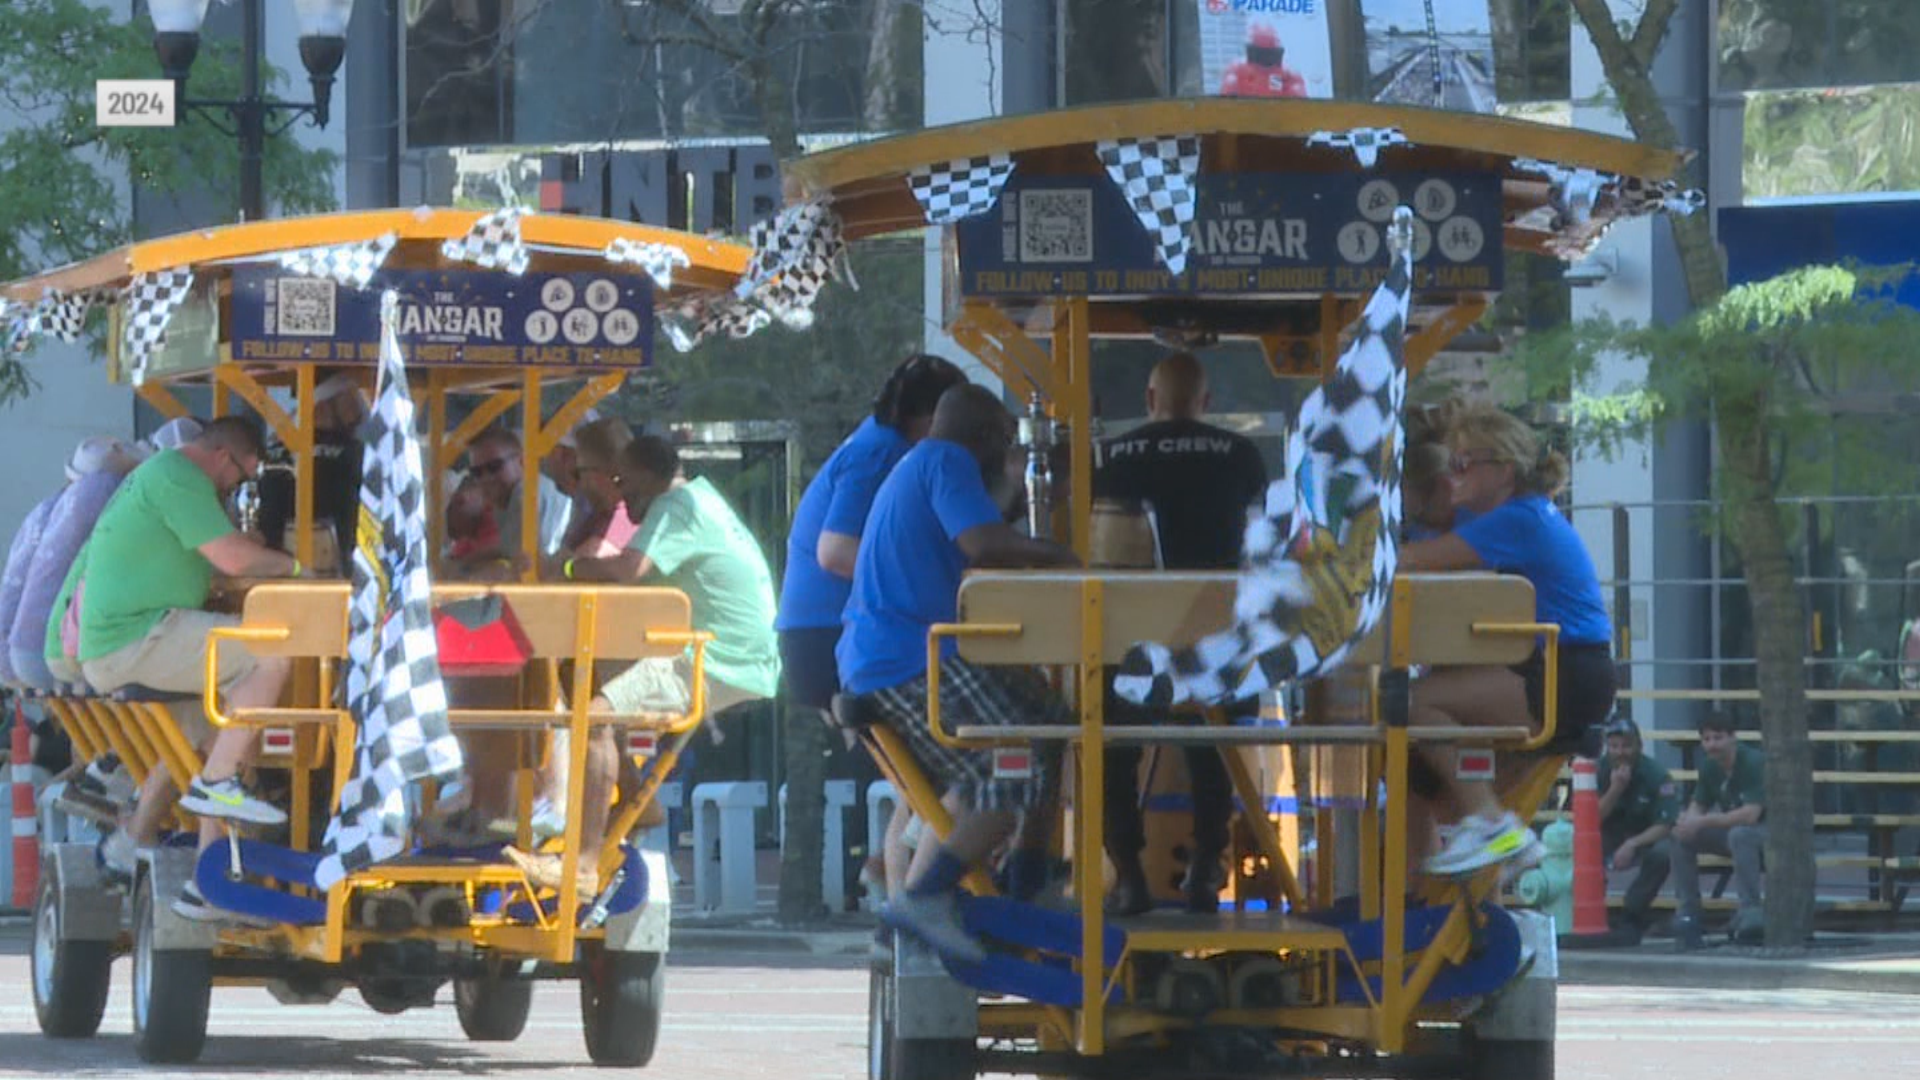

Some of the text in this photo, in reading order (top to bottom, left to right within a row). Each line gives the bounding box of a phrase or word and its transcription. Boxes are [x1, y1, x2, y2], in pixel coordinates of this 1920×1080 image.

[1233, 0, 1315, 13] PARADE
[1219, 201, 1244, 216] THE
[1188, 218, 1309, 260] ANGAR
[977, 271, 1052, 292] FOLLOW
[1096, 271, 1117, 291] TO
[1109, 437, 1233, 459] PIT CREW
